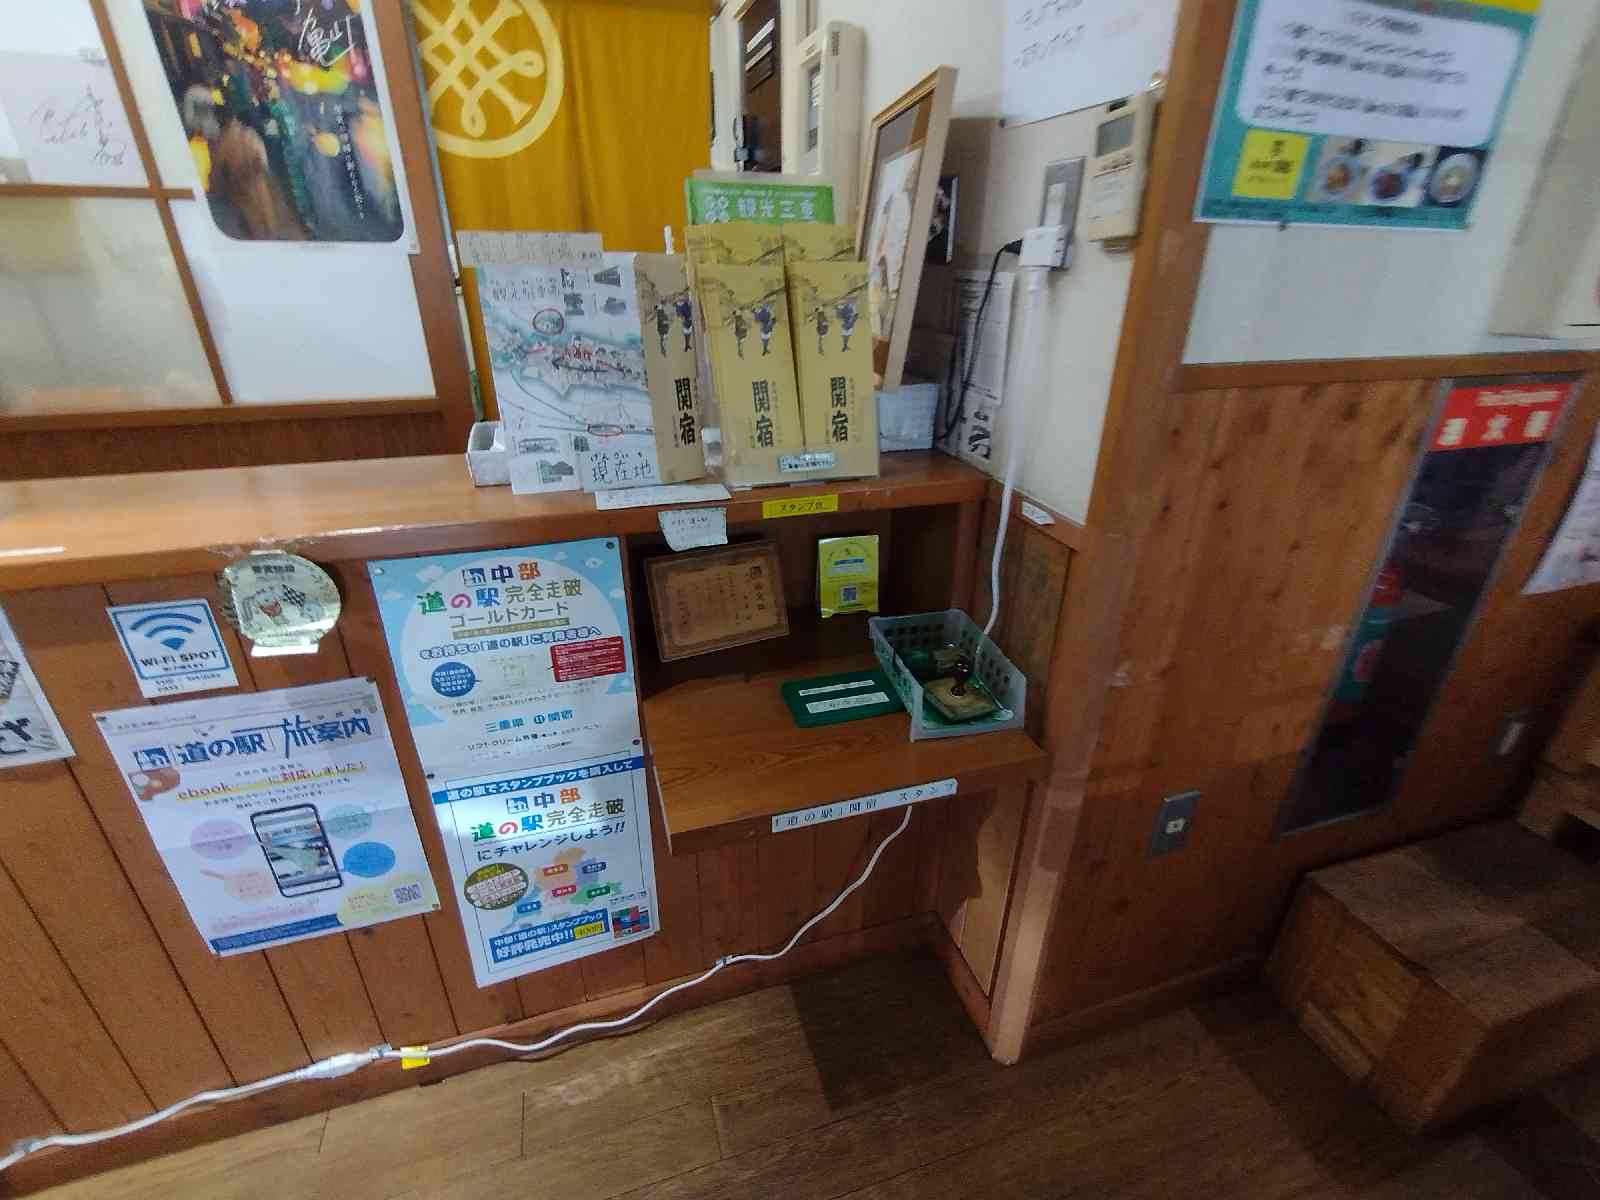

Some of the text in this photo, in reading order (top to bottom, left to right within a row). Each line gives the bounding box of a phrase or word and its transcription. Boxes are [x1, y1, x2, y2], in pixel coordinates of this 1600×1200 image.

[674, 377, 697, 446] 関宿
[751, 380, 775, 448] 関宿
[831, 375, 850, 443] 関宿
[591, 458, 655, 484] 現在地
[490, 561, 542, 584] 中部
[181, 650, 219, 664] SPOT
[533, 787, 582, 809] 中部
